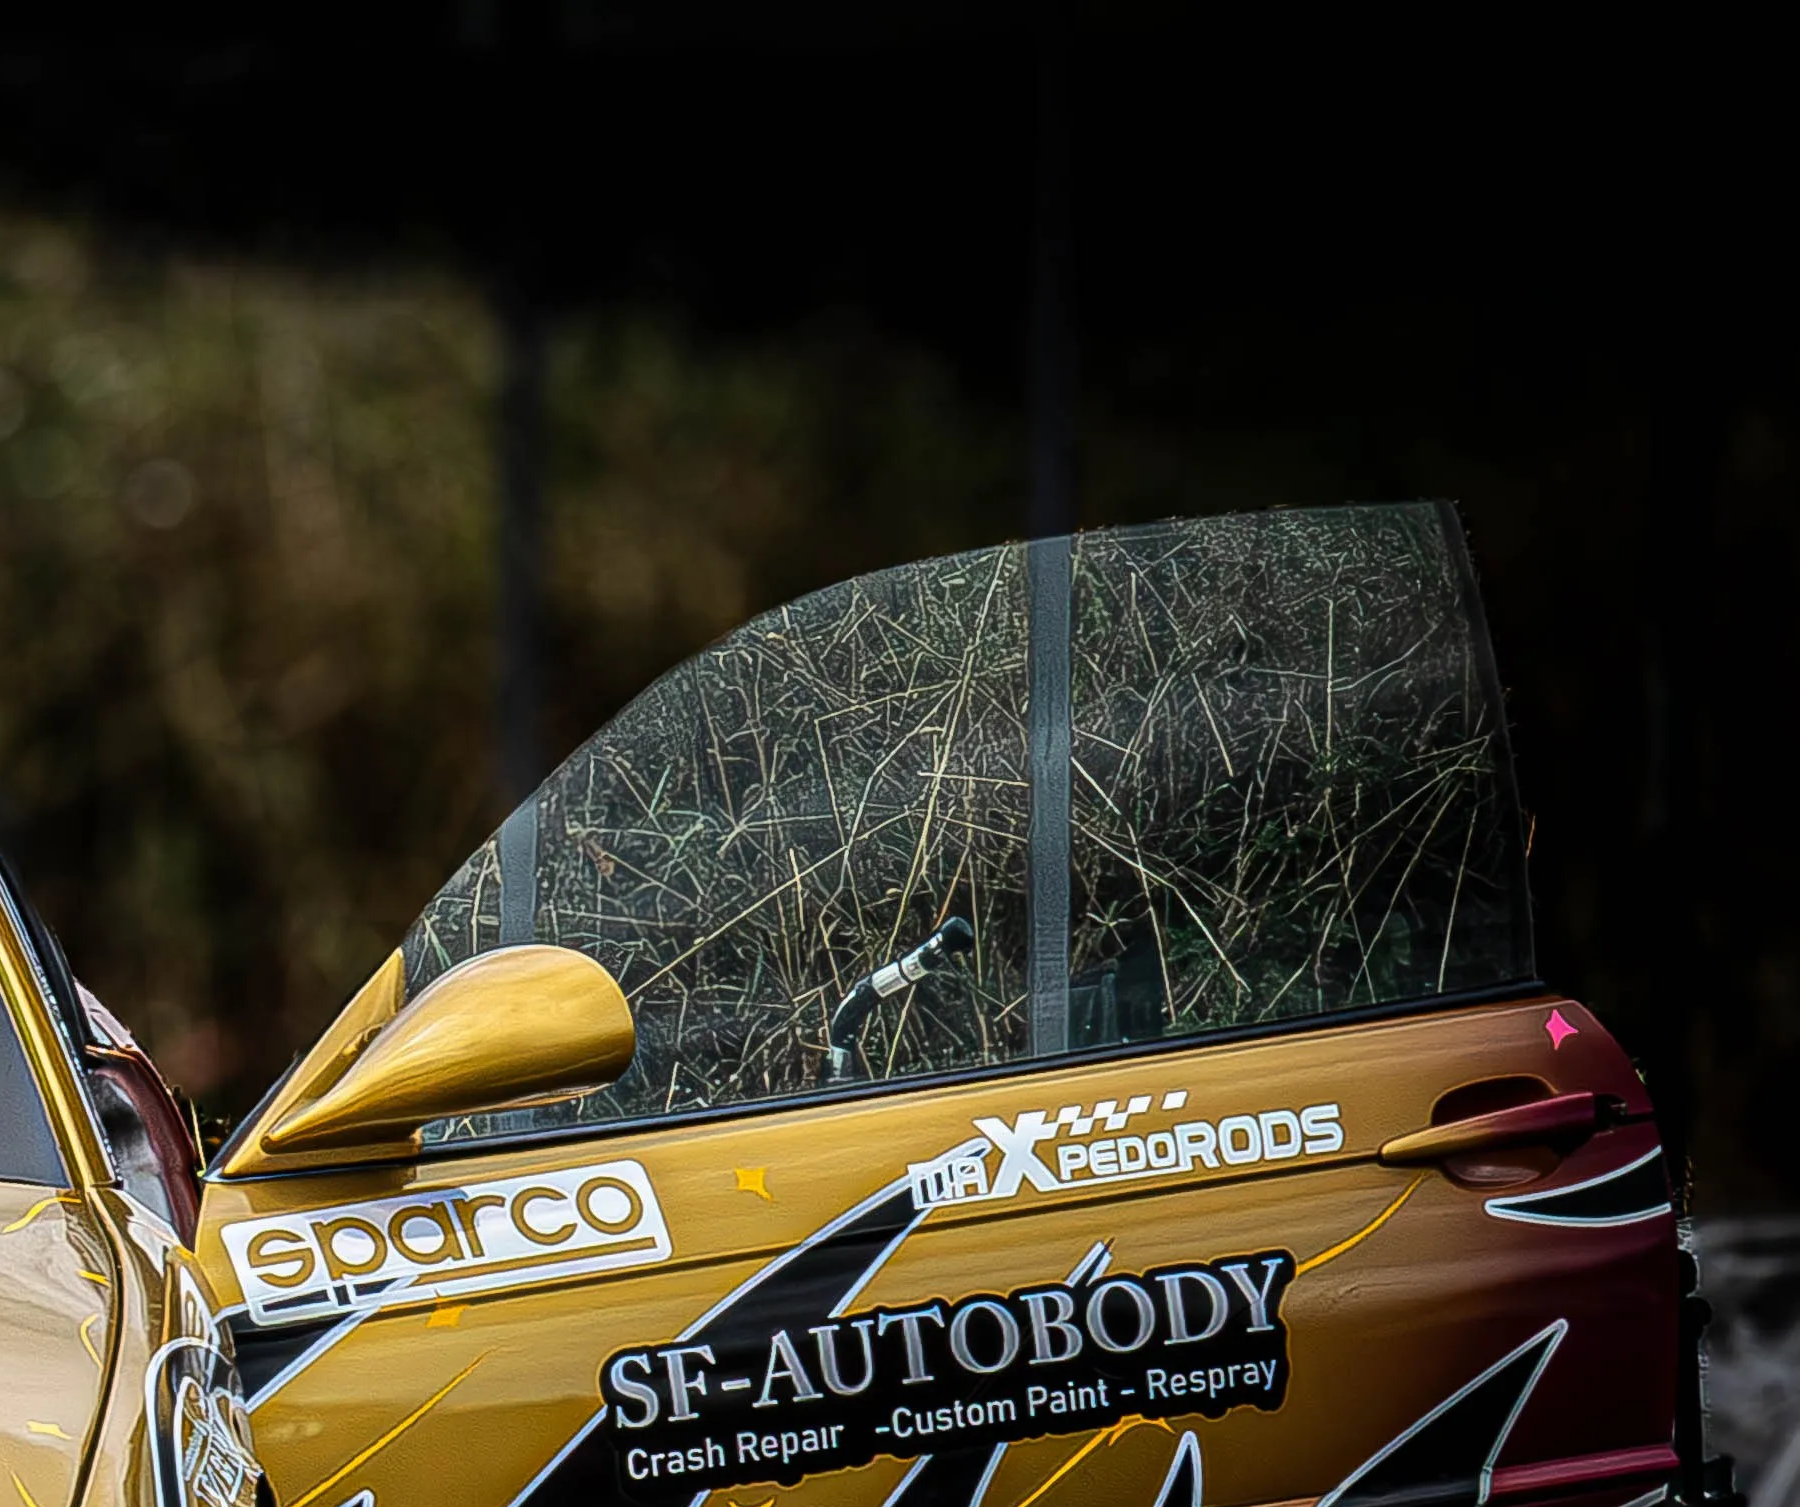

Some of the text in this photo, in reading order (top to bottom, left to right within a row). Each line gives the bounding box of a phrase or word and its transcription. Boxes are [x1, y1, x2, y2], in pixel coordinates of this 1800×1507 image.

[246, 1176, 644, 1306] sparco
[607, 1257, 1284, 1430] SF-AUTOBODY
[627, 1437, 725, 1480] Crash
[736, 1424, 844, 1465] Repair
[1027, 1379, 1109, 1417] Paint
[1146, 1359, 1277, 1399] Respray
